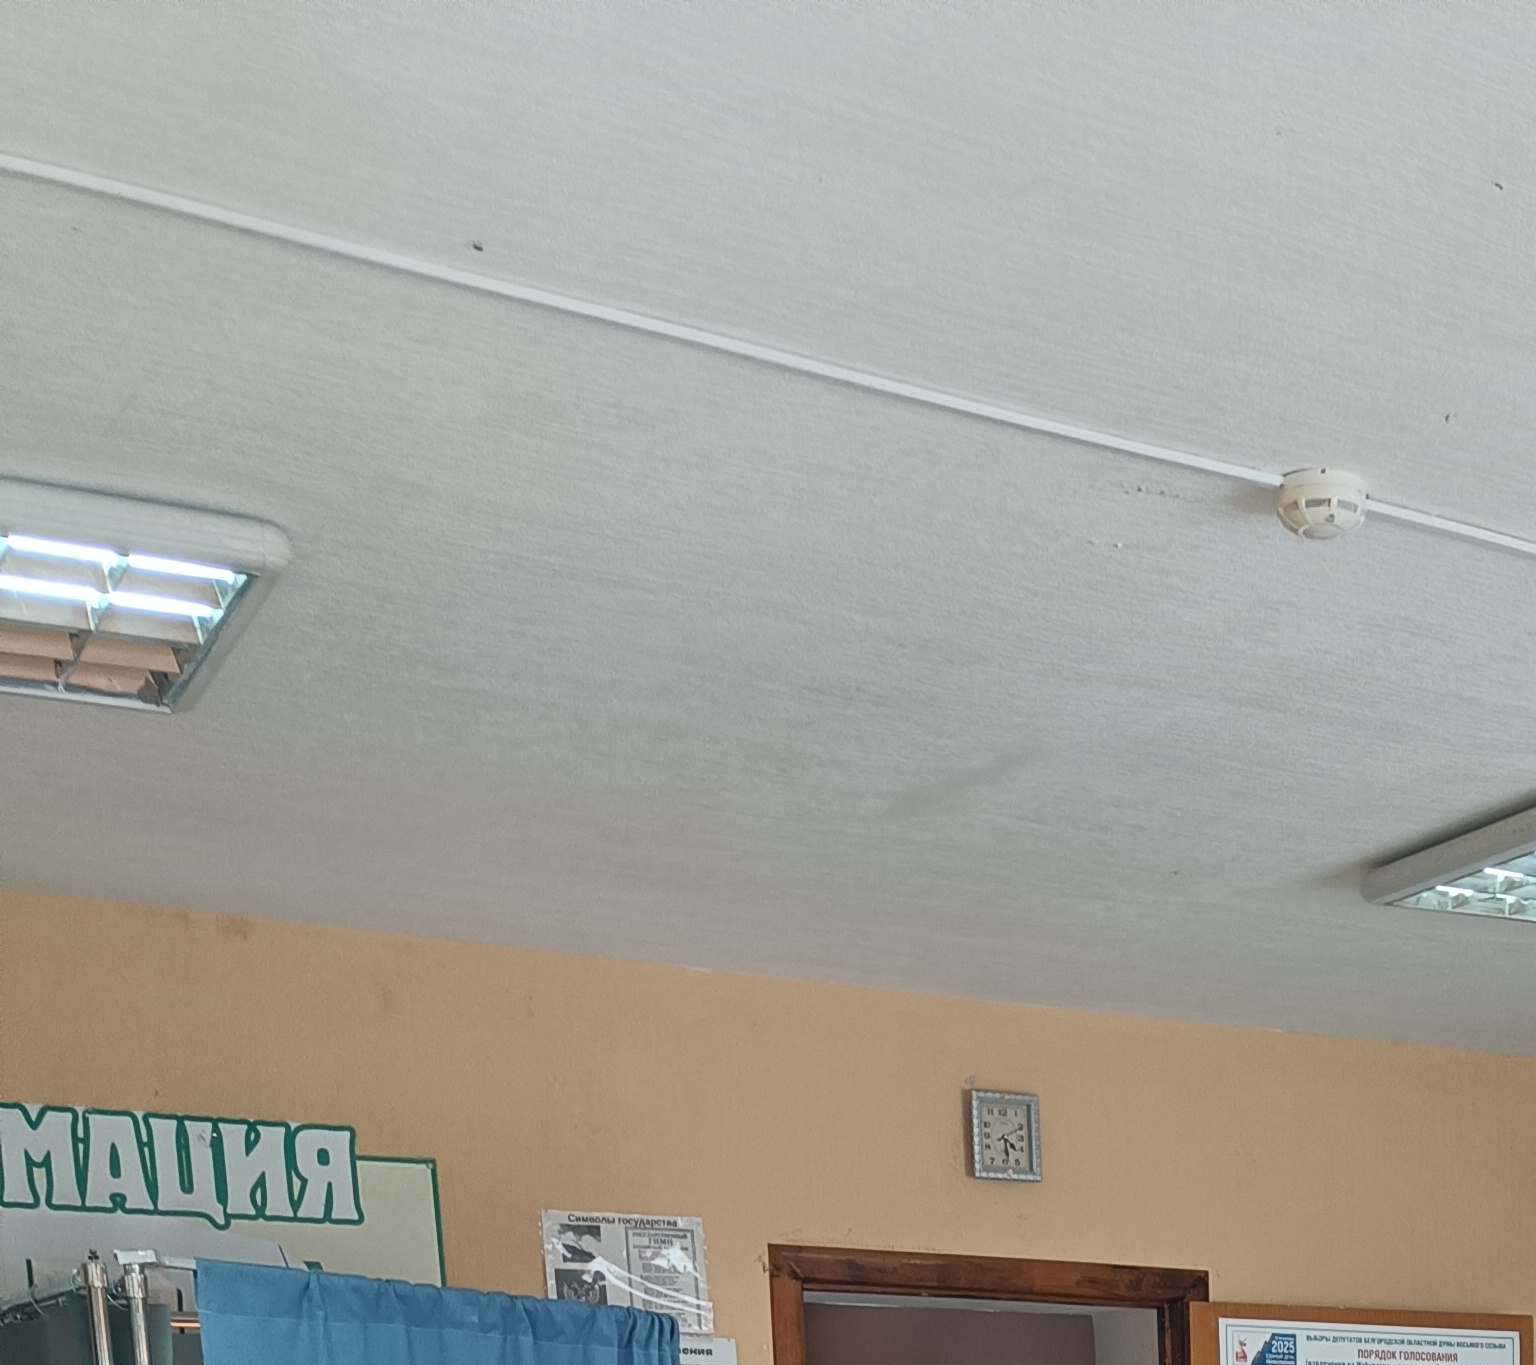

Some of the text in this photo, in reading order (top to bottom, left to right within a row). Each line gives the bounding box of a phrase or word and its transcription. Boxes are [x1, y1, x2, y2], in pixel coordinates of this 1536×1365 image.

[0, 1102, 364, 1230] МАЦИЯ
[567, 1213, 678, 1228] Символы государства
[679, 1347, 713, 1356] ения
[1271, 1340, 1295, 1354] 2025
[1357, 1348, 1458, 1363] ПОРЯДОК ГОЛОСОВАНИЯ
